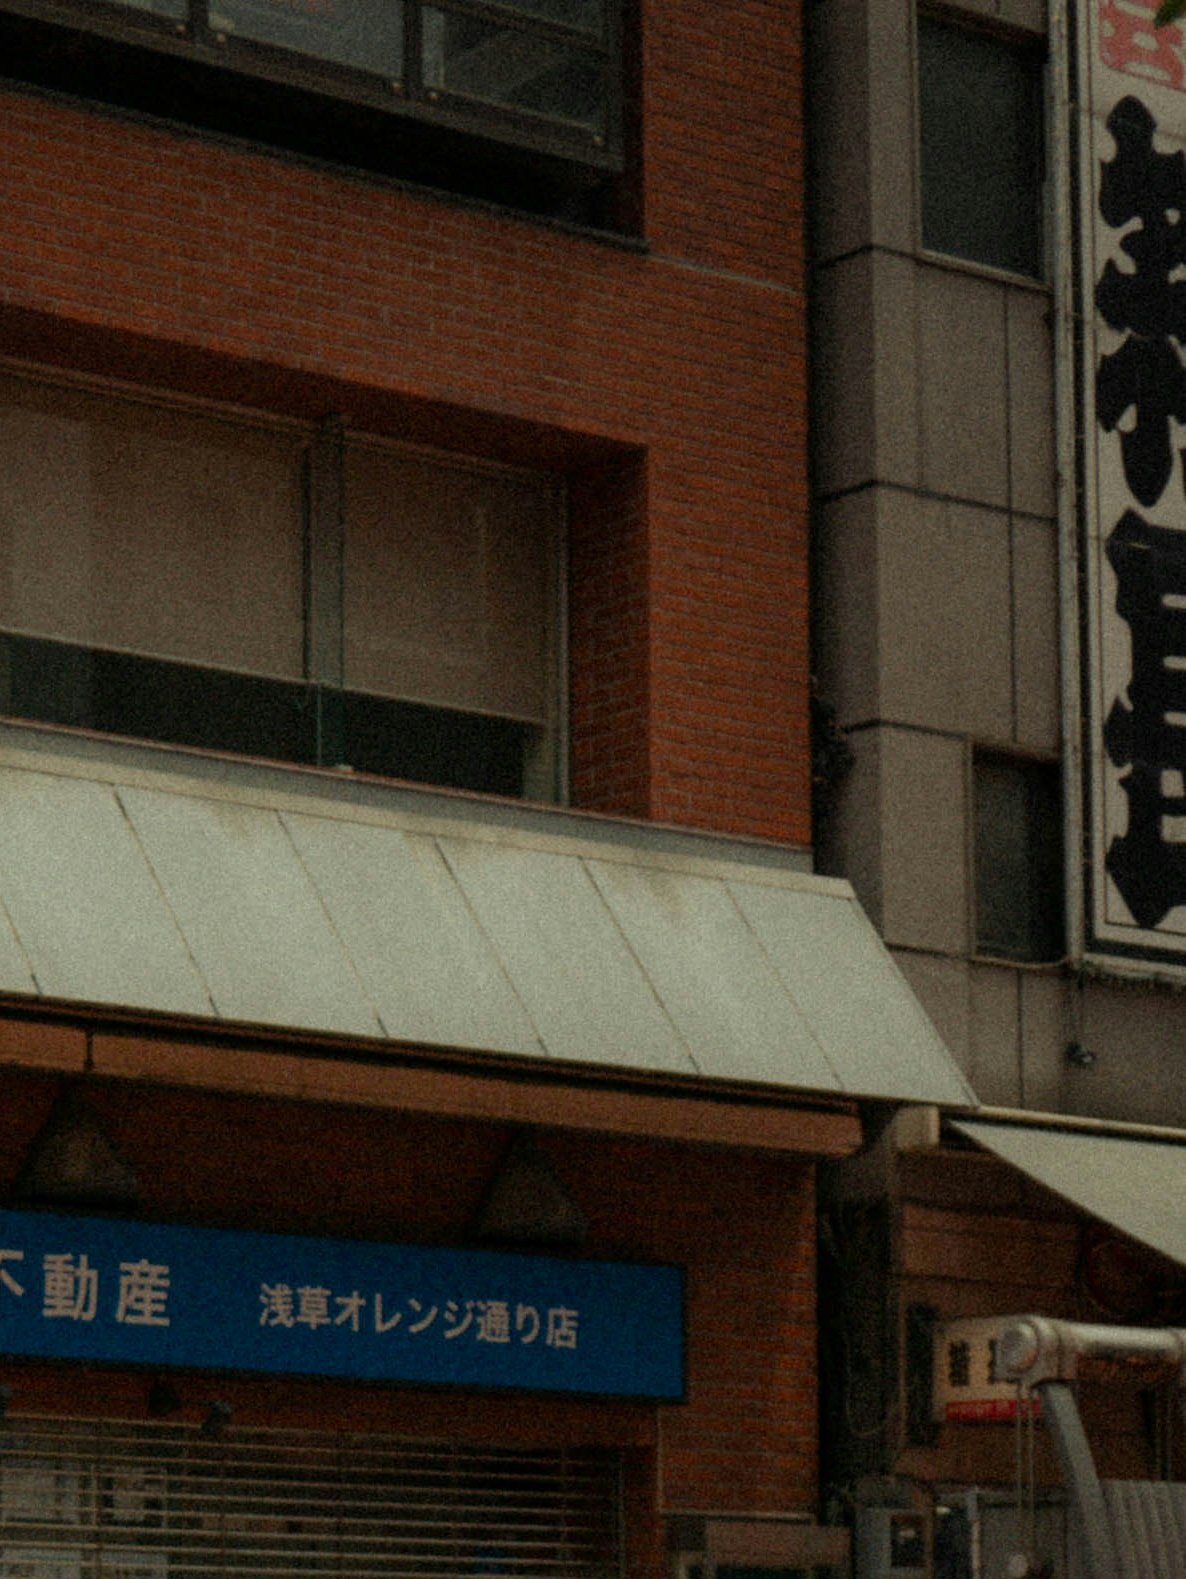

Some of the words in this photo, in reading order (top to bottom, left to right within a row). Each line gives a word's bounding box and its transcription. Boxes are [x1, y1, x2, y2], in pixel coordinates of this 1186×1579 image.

[258, 1283, 580, 1350] 浅草オレンジ通り店
